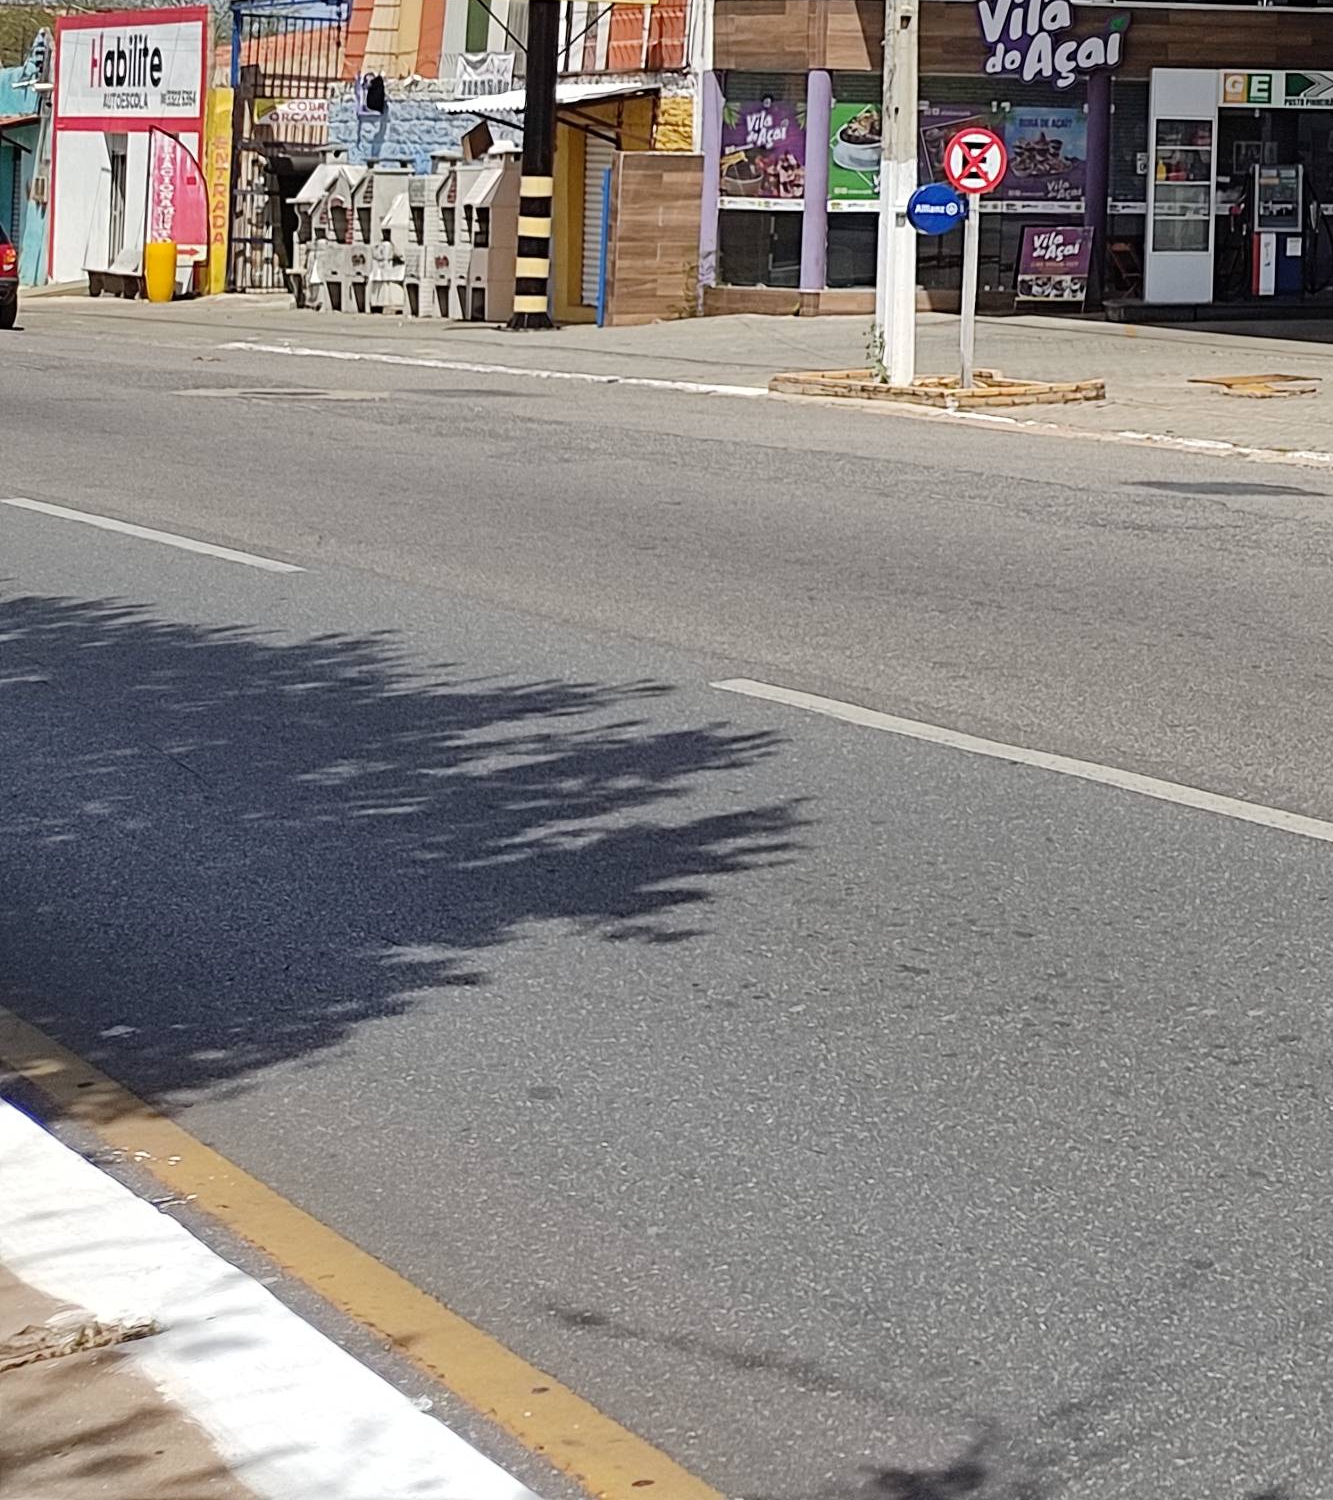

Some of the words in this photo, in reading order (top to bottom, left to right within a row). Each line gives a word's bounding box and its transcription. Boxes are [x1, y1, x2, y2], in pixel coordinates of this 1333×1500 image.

[90, 31, 163, 88] Habilite
[985, 42, 1022, 74] do
[1225, 74, 1244, 93] G
[1249, 75, 1271, 98] E
[746, 111, 773, 132] Vila
[914, 203, 945, 214] Allianz
[1033, 231, 1064, 249] Vila
